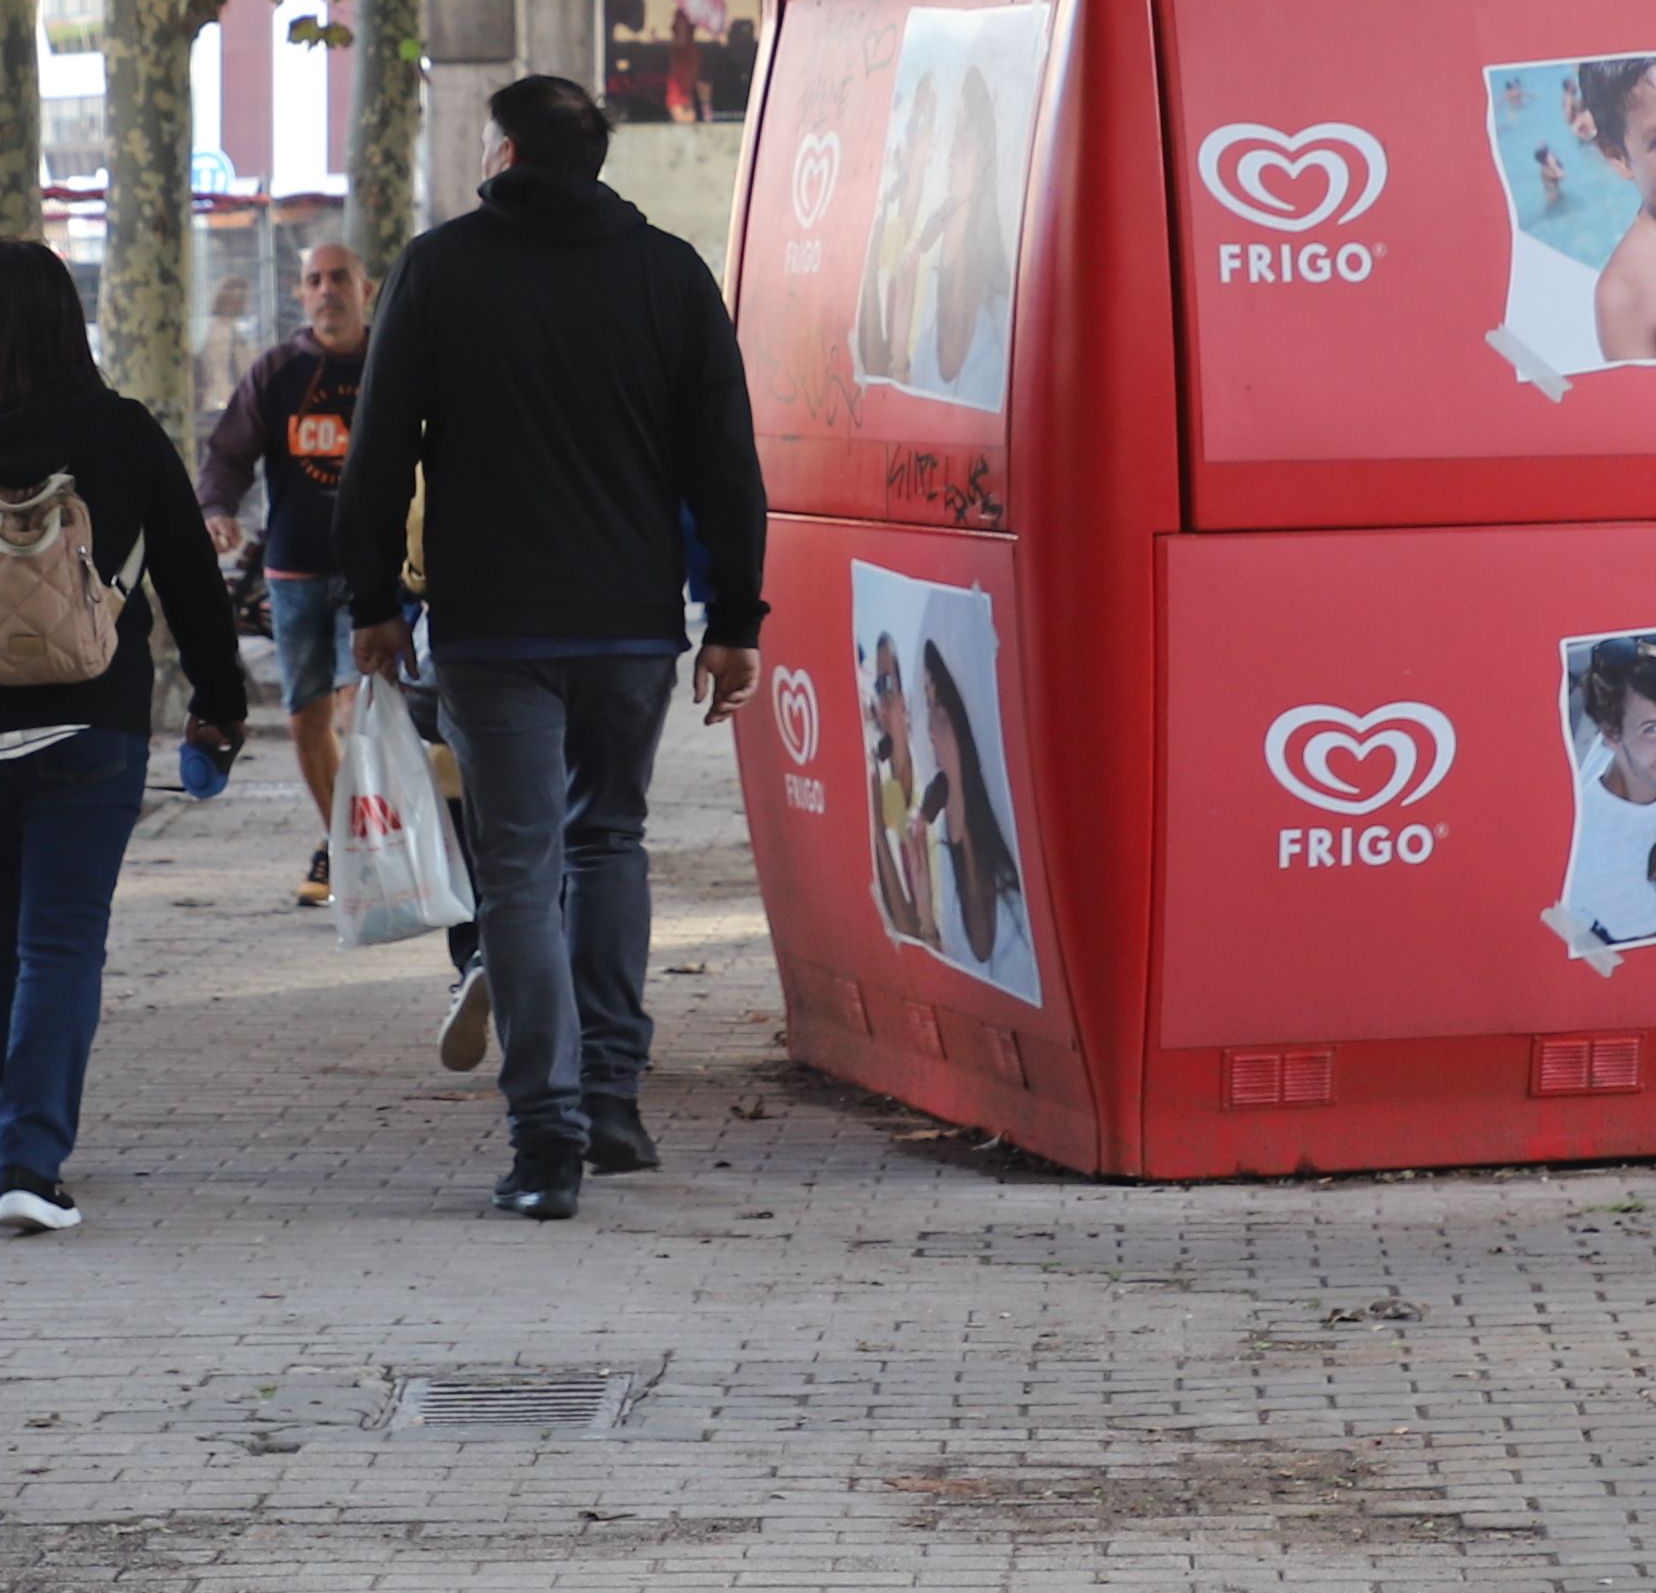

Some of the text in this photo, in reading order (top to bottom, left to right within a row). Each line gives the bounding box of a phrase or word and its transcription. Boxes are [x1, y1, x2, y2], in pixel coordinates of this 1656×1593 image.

[1219, 242, 1372, 284] FRIGO
[785, 773, 825, 814] FRIGO
[1279, 824, 1434, 869] FRIGO
